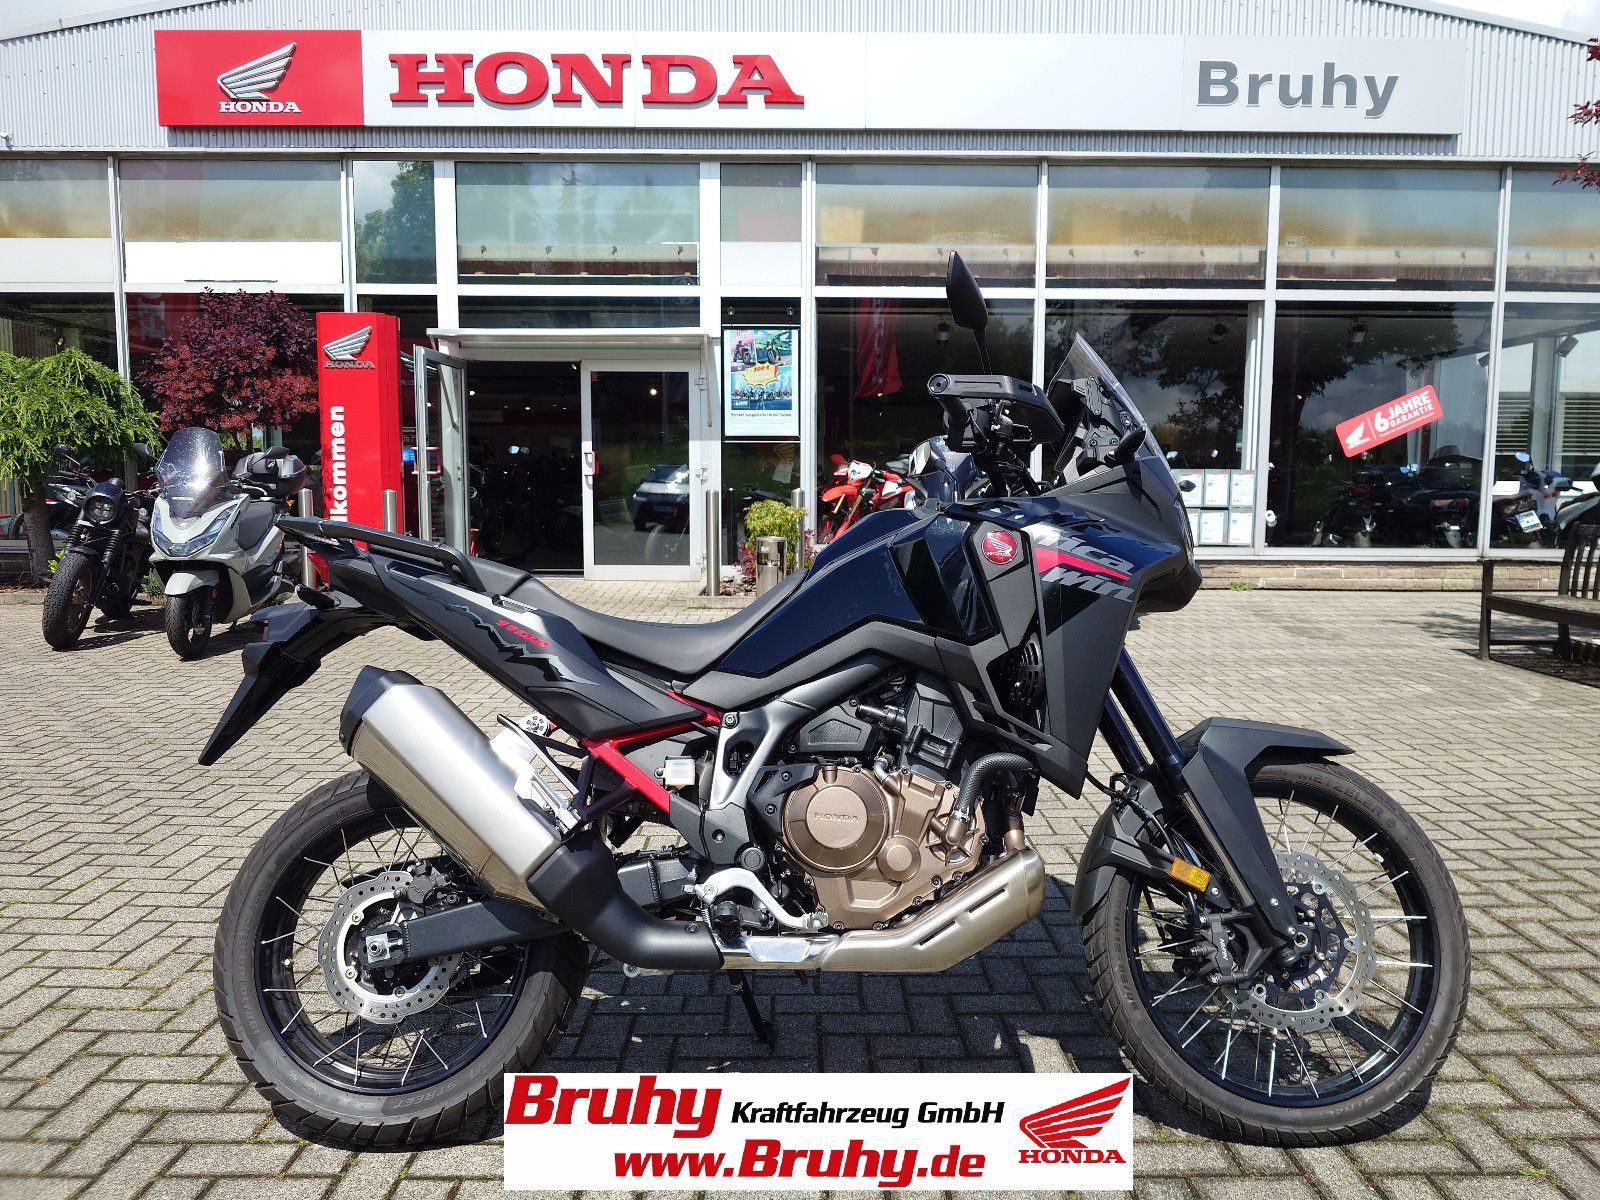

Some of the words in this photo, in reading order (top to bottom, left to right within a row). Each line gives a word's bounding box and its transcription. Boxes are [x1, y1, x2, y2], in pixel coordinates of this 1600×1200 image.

[388, 52, 805, 106] HONDA
[1197, 60, 1400, 118] Bruhy
[219, 101, 302, 113] HONDA
[324, 359, 376, 370] HONDA
[1374, 411, 1390, 433] 6
[1388, 391, 1431, 420] JAHRE
[1389, 403, 1434, 428] GARANTIE
[814, 812, 860, 823] HONDA
[393, 1079, 458, 1109] STREET
